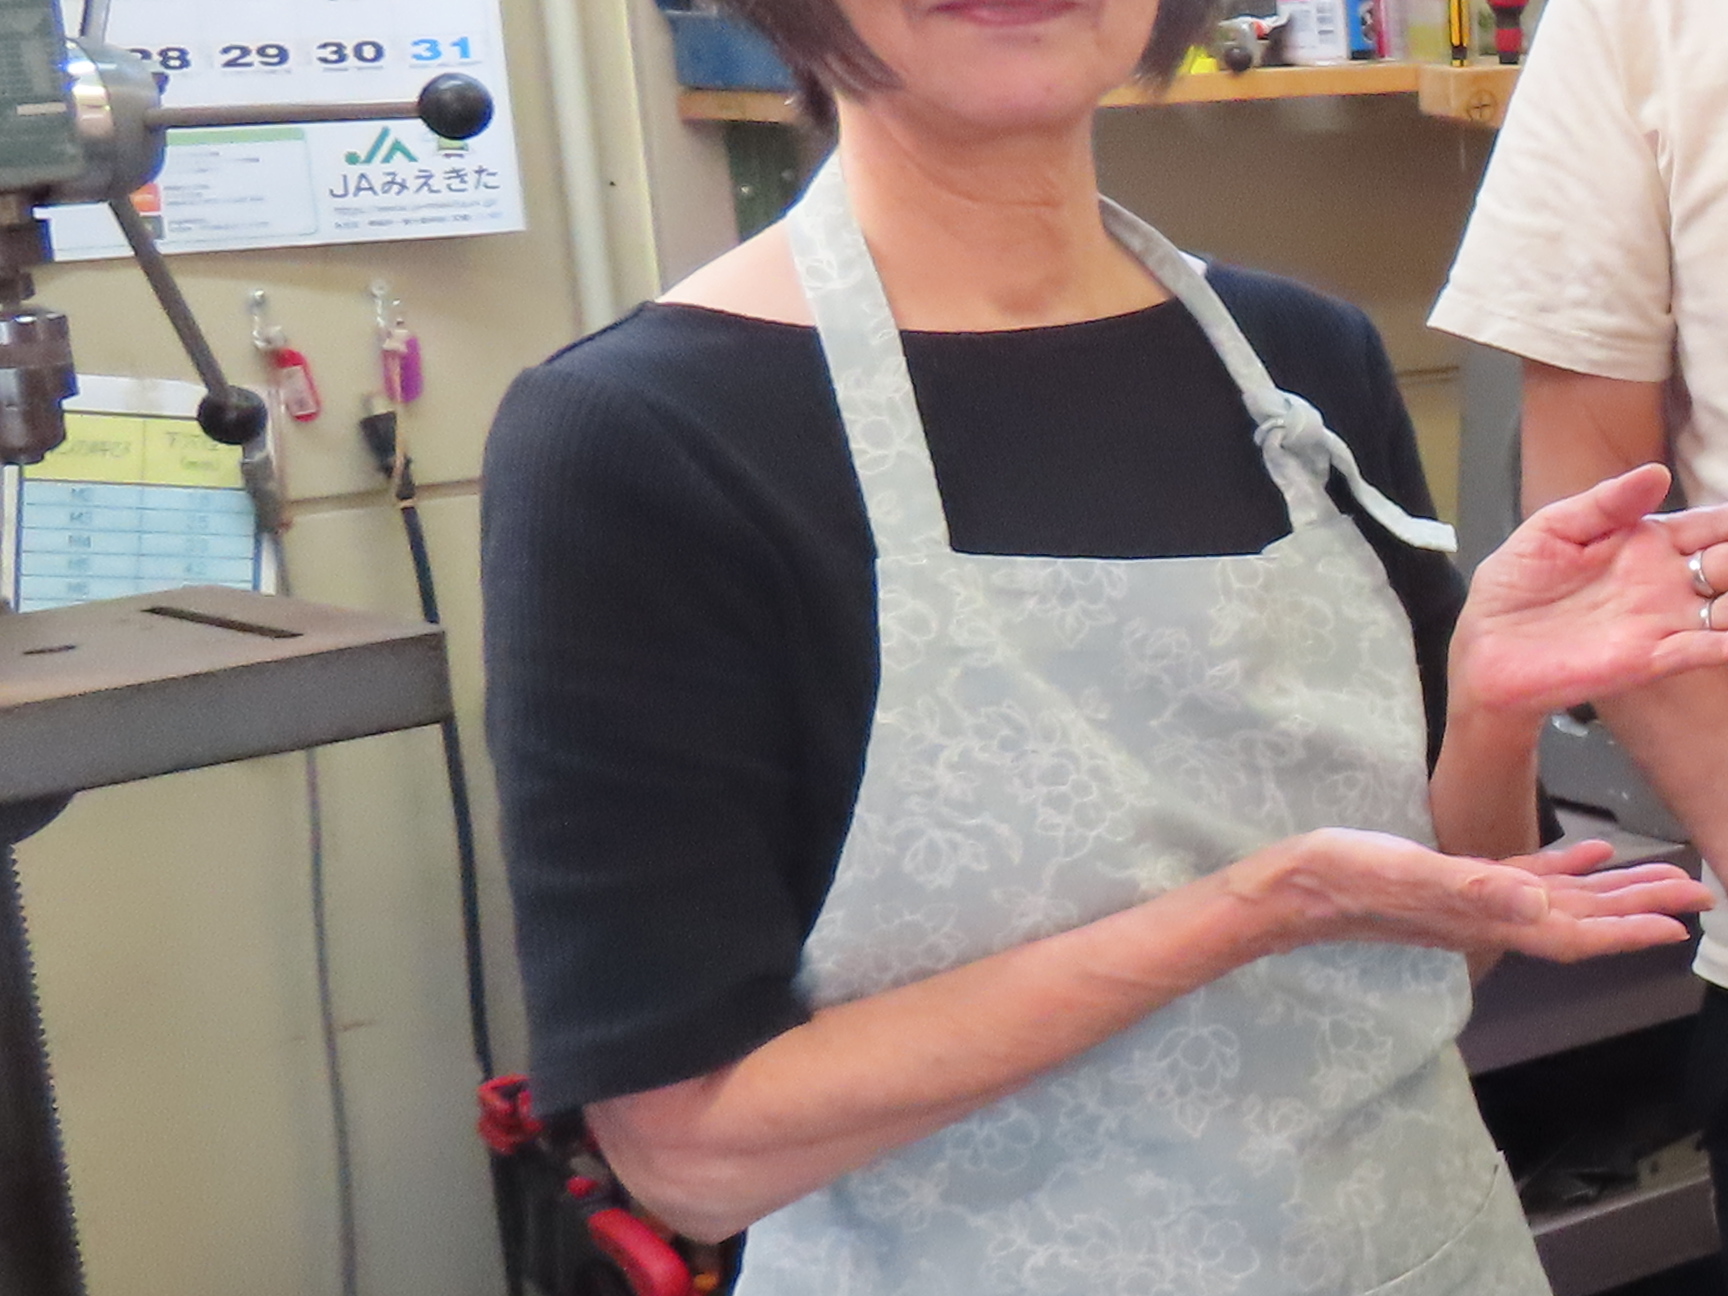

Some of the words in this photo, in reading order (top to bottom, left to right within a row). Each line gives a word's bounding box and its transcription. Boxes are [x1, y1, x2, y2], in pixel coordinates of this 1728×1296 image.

[219, 44, 289, 68] 29
[316, 41, 385, 65] 30
[410, 37, 472, 60] 31
[329, 165, 501, 199] JAみえきた
